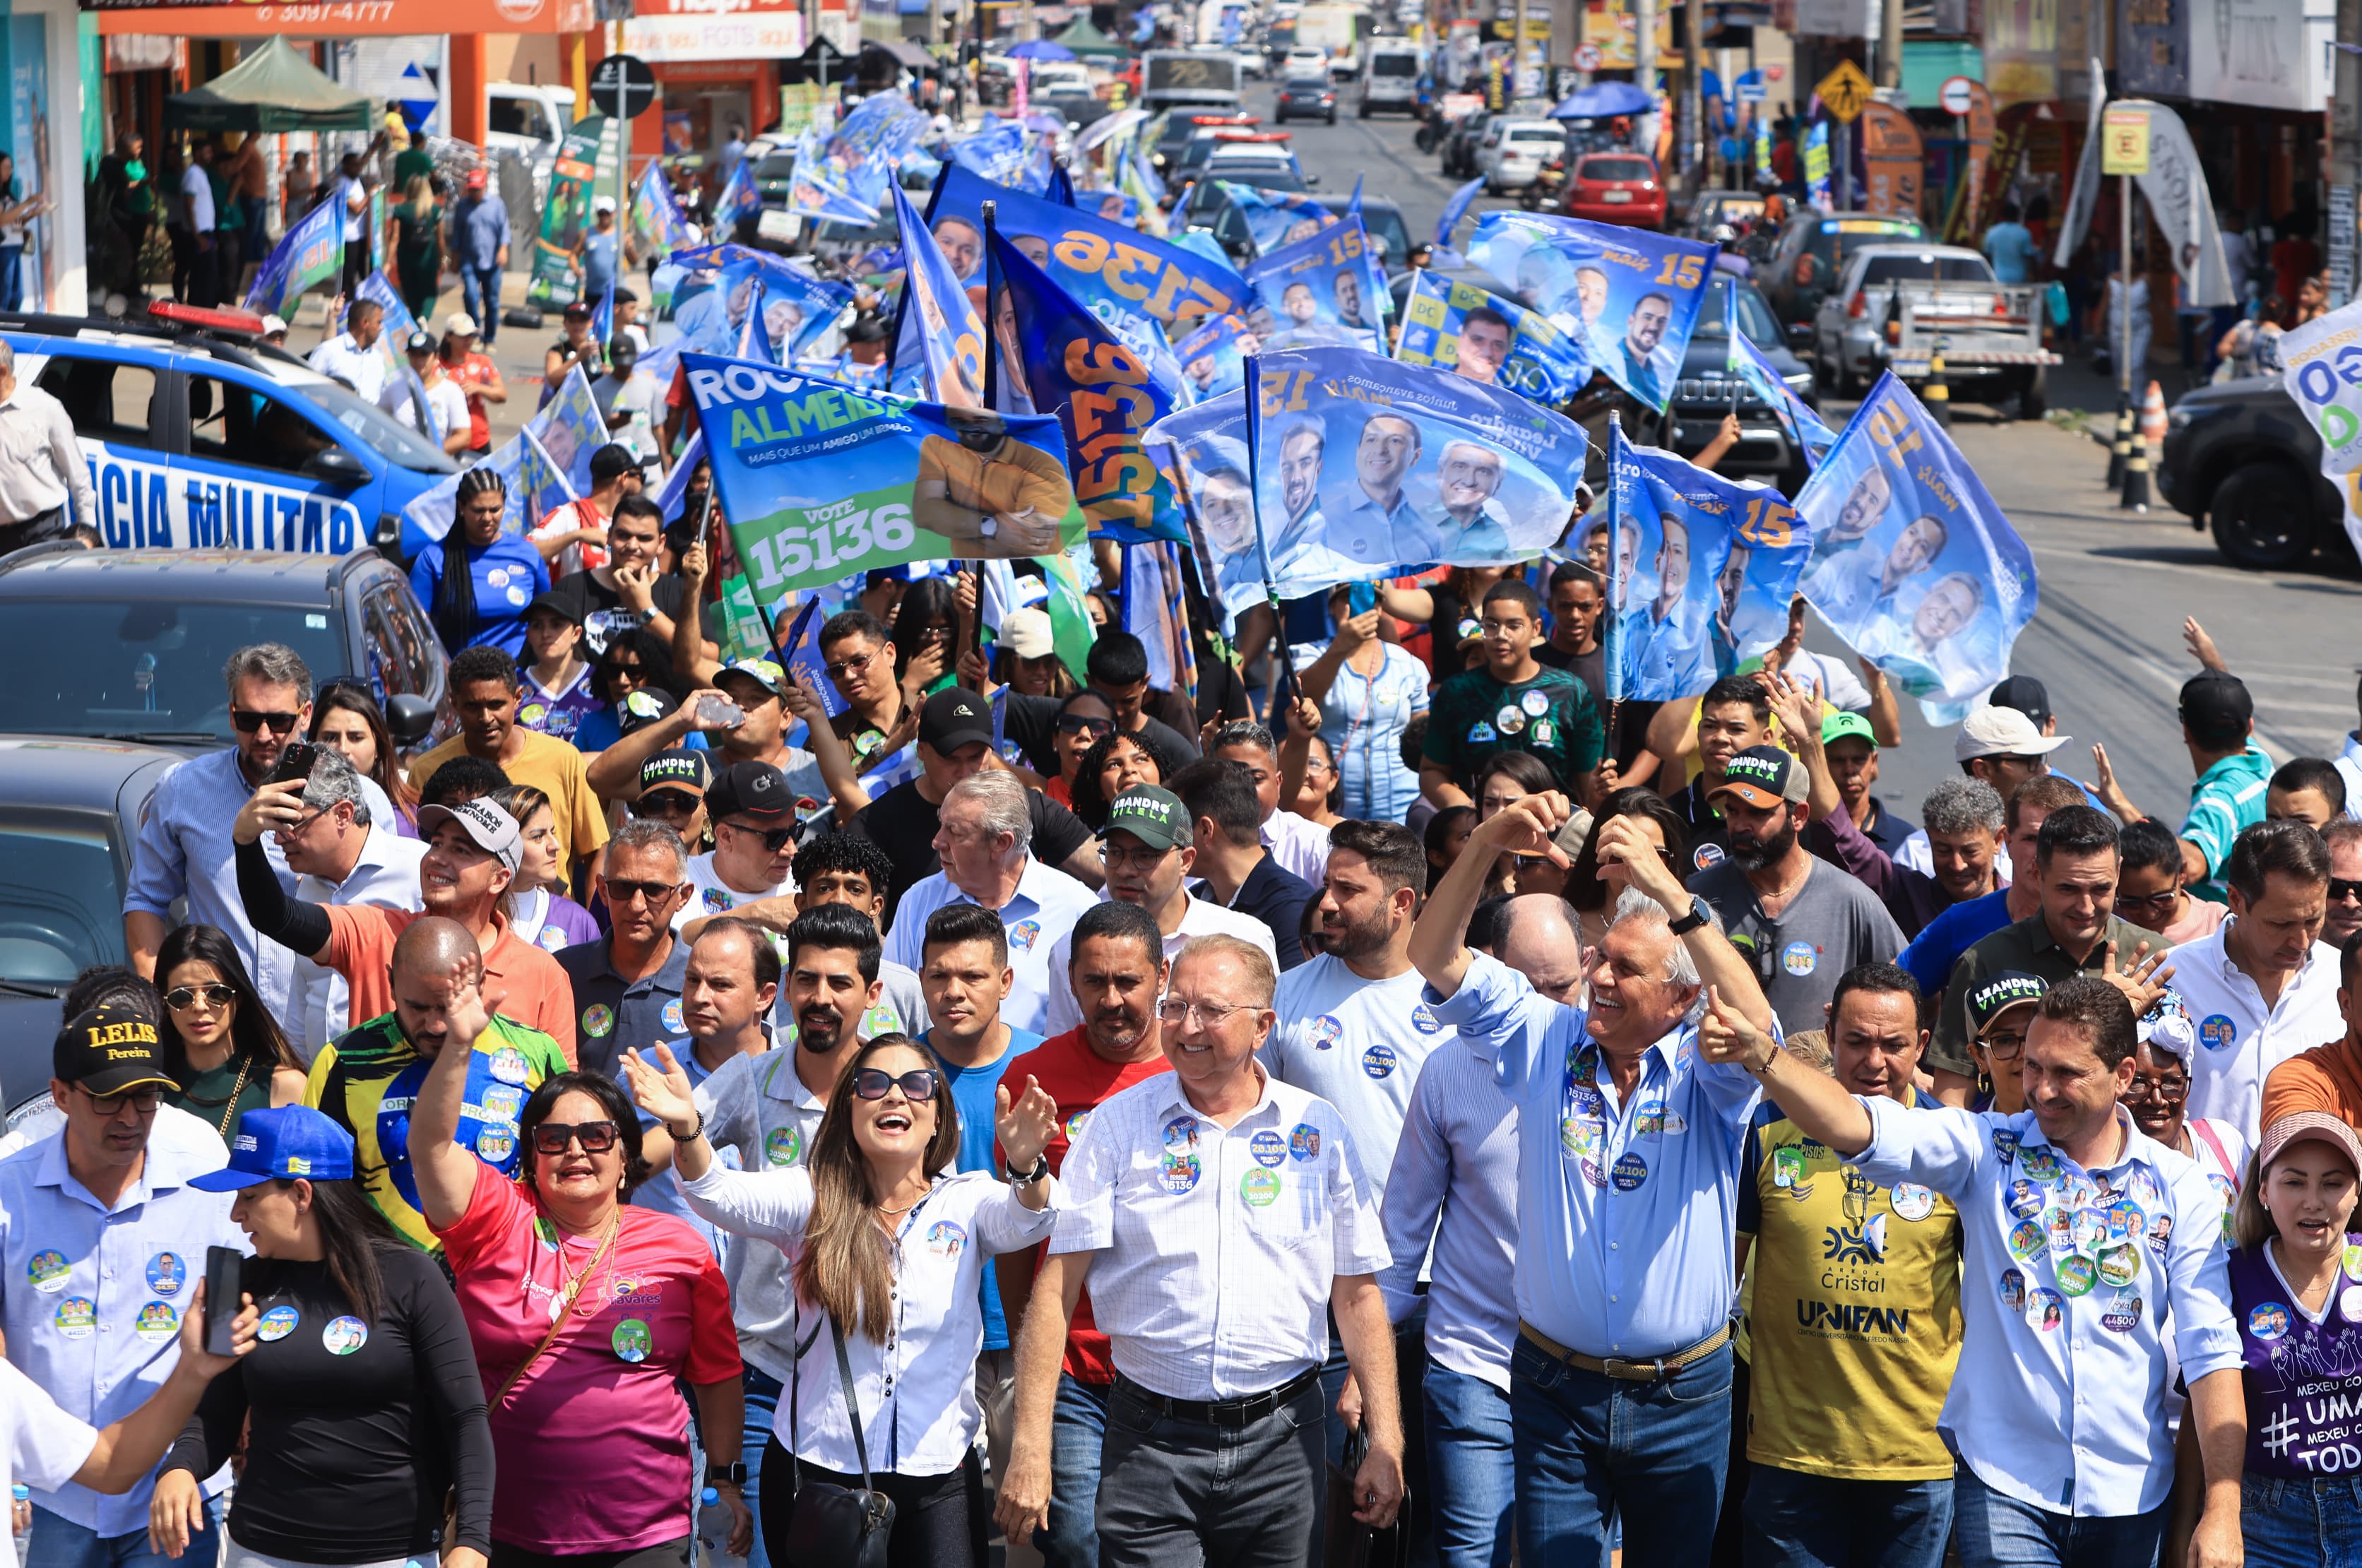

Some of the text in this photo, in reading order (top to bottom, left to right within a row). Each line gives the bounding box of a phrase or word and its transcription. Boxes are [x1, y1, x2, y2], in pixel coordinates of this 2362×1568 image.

[1328, 230, 1363, 267] 15
[1654, 251, 1707, 290] 15
[1416, 302, 1437, 319] DC
[748, 451, 776, 465] MAIS
[777, 445, 802, 458] QUE
[802, 441, 821, 454] UM
[821, 431, 859, 451] AMIGO
[857, 427, 874, 440] UM
[802, 497, 856, 525] VOTE
[1738, 497, 1796, 548] 15
[749, 502, 915, 592] 15136
[643, 759, 696, 773] LEANDRO
[1728, 756, 1777, 773] LEANDRO
[643, 768, 696, 781] VILELA
[1726, 765, 1774, 782] VILELA
[1113, 796, 1170, 814] LEANDRO
[1112, 805, 1168, 825] VILELA
[1974, 977, 2039, 1004] LEANDRO
[1976, 987, 2042, 1011] VILELA
[666, 1005, 679, 1018] 15
[88, 1023, 158, 1047] LELIS
[2203, 1023, 2219, 1035] 15
[107, 1047, 151, 1060] Pereira
[1364, 1055, 1396, 1067] 20.100
[1567, 1088, 1598, 1102] 15136
[1252, 1144, 1287, 1153] 20.100
[1292, 1133, 1305, 1147] 15
[768, 1149, 790, 1159] 20200
[1613, 1165, 1647, 1177] 20.100
[1163, 1180, 1194, 1190] 15136
[2111, 1209, 2126, 1224] 15
[1820, 1272, 1886, 1294] Cristal
[2060, 1273, 2085, 1290] 20200
[608, 1293, 662, 1306] Tavares
[1796, 1298, 1909, 1336] UNIFAN
[2104, 1315, 2135, 1326] 44500
[2253, 1312, 2269, 1326] 15
[2296, 1380, 2338, 1398] MEXEU
[2307, 1427, 2349, 1445] MEXEU
